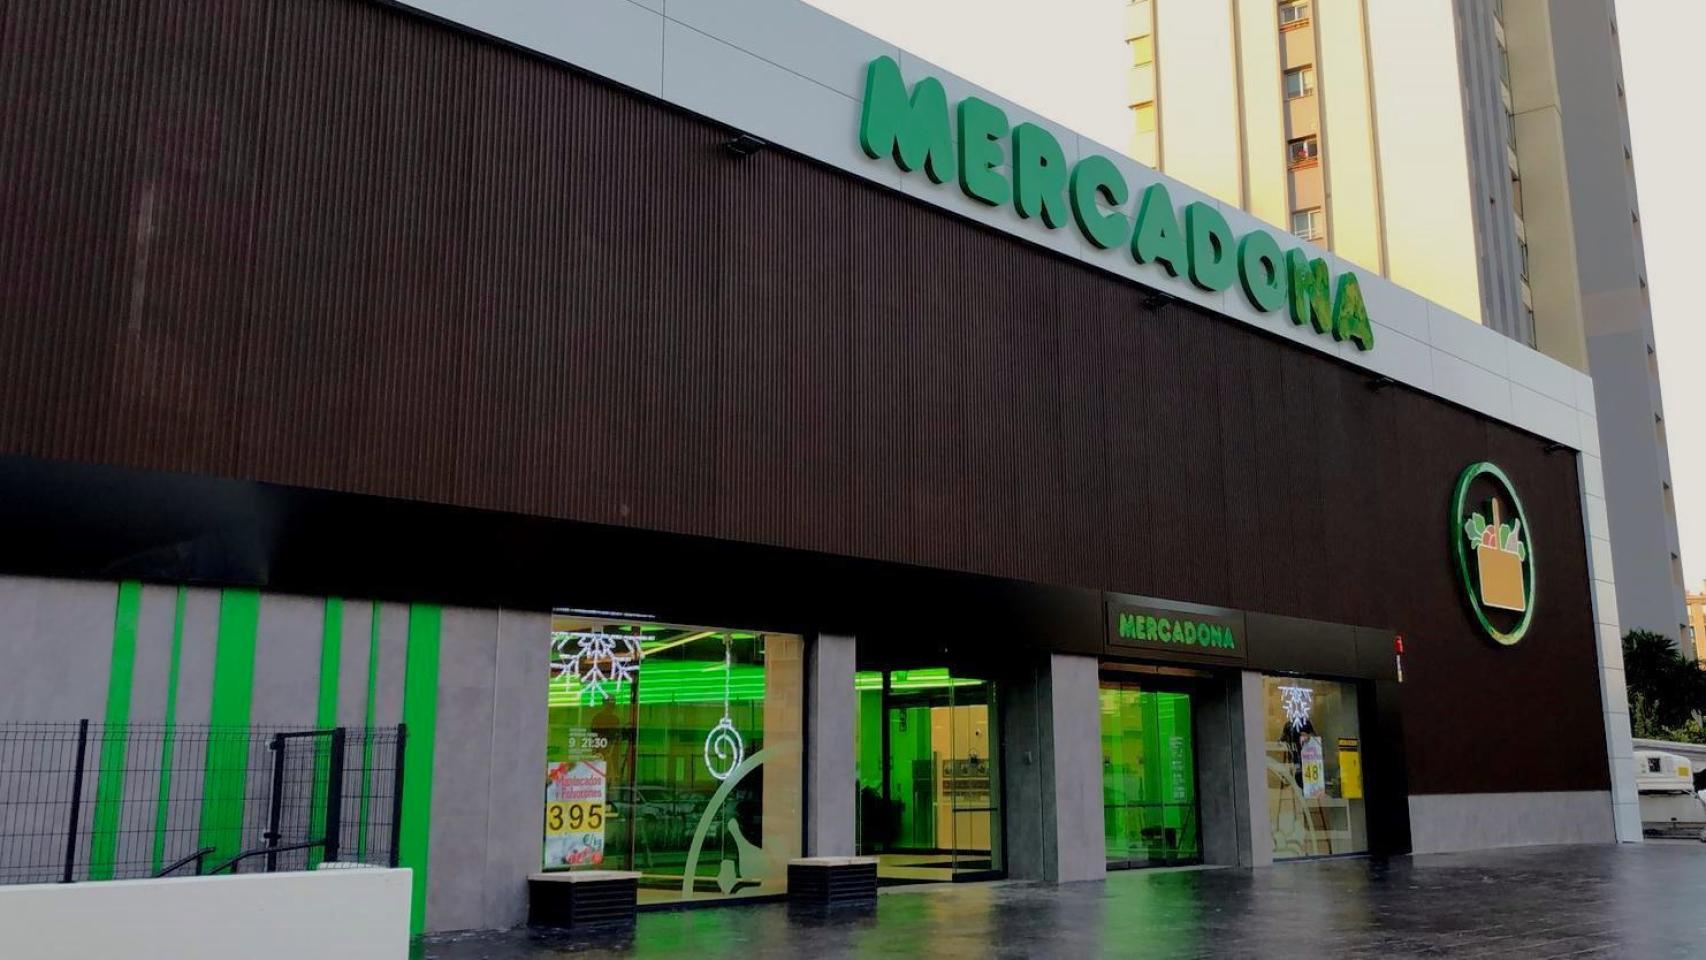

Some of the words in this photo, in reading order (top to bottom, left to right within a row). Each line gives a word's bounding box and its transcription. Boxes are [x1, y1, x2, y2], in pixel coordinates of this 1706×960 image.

[860, 54, 1375, 352] MERCADONA
[1119, 612, 1235, 650] MERCADONA
[568, 737, 576, 748] 9
